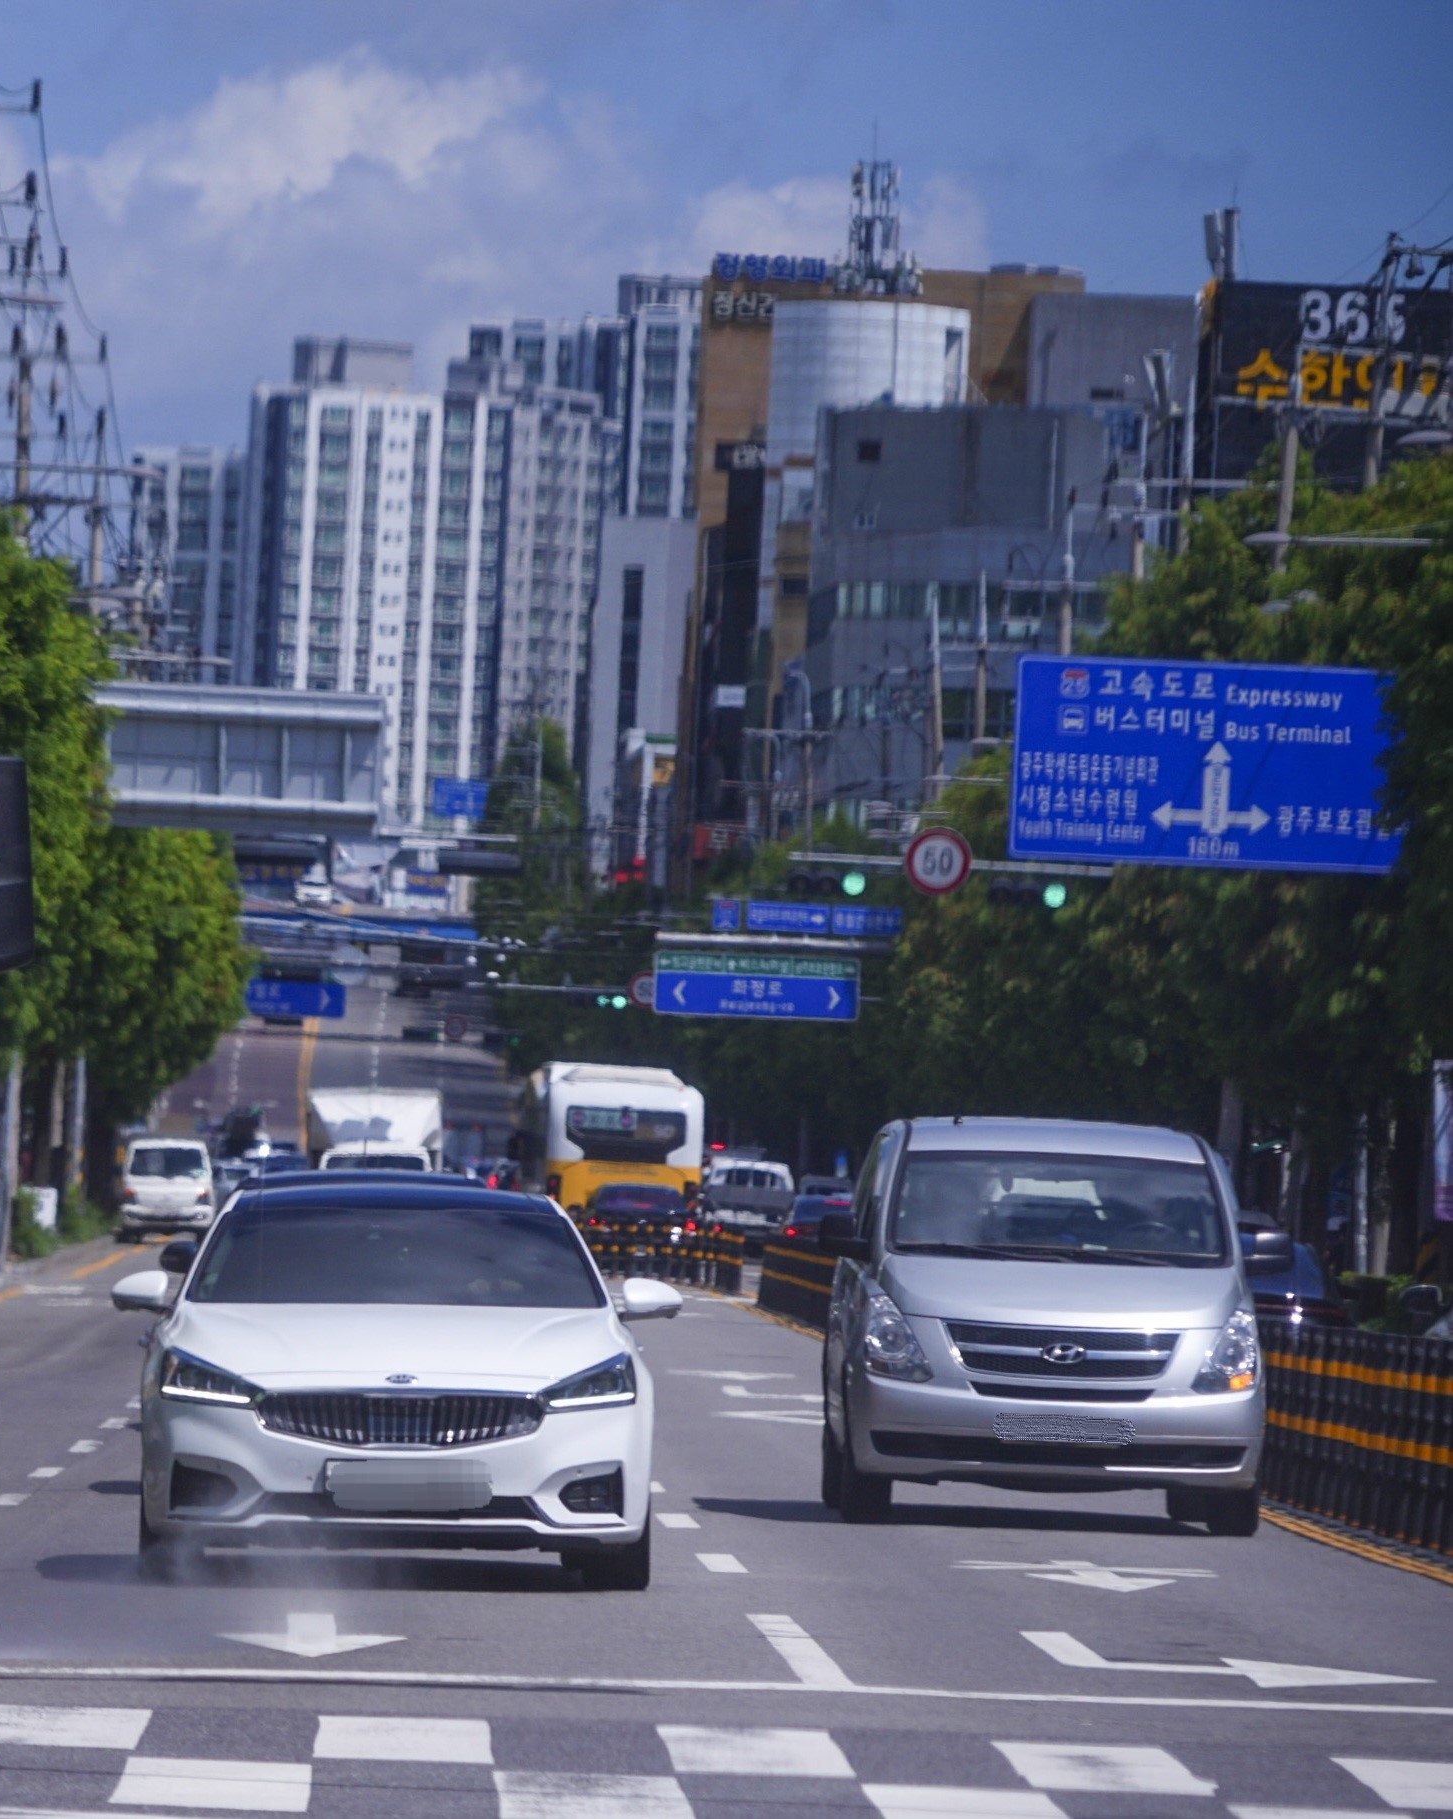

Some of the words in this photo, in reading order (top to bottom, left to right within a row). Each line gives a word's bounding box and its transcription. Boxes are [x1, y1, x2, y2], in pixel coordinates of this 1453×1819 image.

[714, 252, 826, 284] 정형외과
[1300, 289, 1406, 344] 365
[1098, 669, 1216, 702] 고속도로
[1226, 684, 1343, 713] Expressway
[1095, 705, 1215, 741] 버스터미널
[1225, 721, 1260, 740] Bus
[1265, 722, 1351, 744] Terminal
[1020, 784, 1138, 821] 시청소년수련원
[1018, 817, 1053, 840] Youth
[1056, 818, 1103, 845] Training
[1106, 819, 1146, 842] Center
[1187, 836, 1240, 858] 180m
